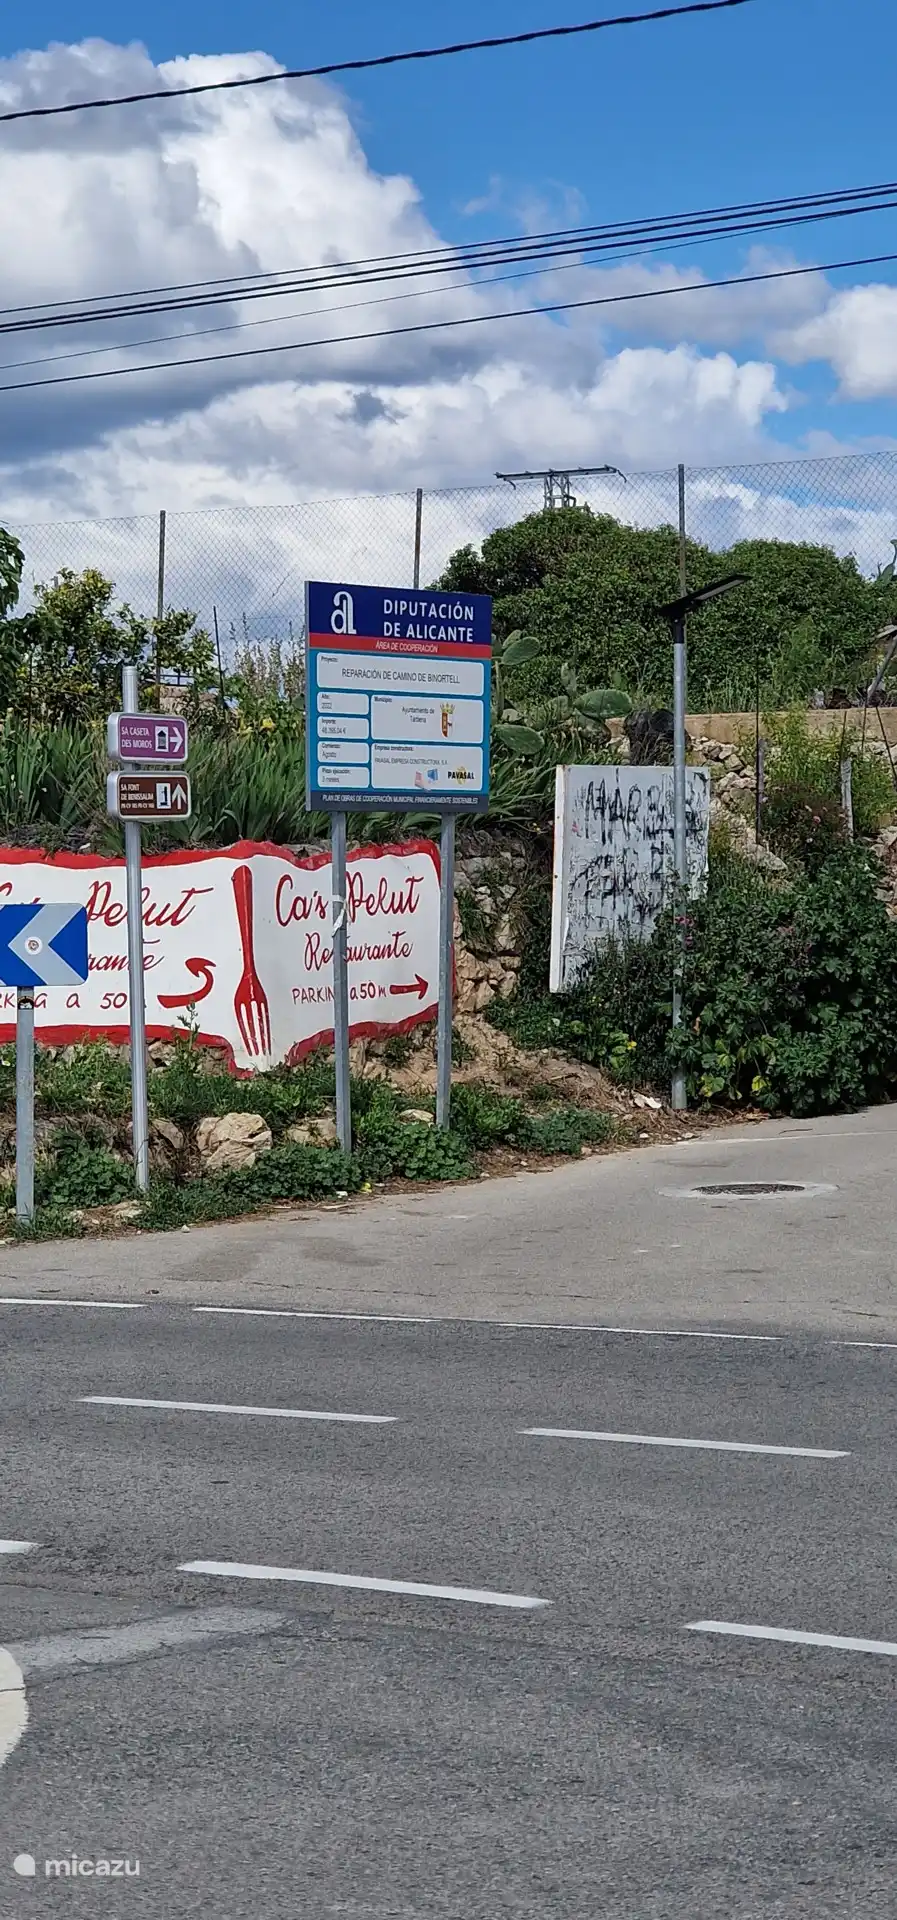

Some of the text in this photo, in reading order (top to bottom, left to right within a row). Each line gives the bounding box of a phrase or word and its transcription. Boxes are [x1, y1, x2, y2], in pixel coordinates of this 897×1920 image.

[383, 599, 474, 621] DIPUTACIÓN
[383, 621, 474, 643] DE ALICANTE
[375, 640, 439, 653] ÁREA DE COOPERACIÓN
[382, 671, 392, 680] DE
[392, 671, 417, 682] CAMINO
[417, 673, 427, 682] DE
[121, 726, 150, 737] SA CASETA
[121, 739, 153, 749] DES MOROS
[447, 771, 475, 780] PAVASAL
[121, 783, 128, 791] SA
[276, 871, 424, 927] Ca's Pelut
[304, 930, 413, 971] Reaurante
[66, 992, 81, 1009] a
[100, 992, 128, 1009] 50
[292, 982, 387, 1005] PARKIN a 50 m
